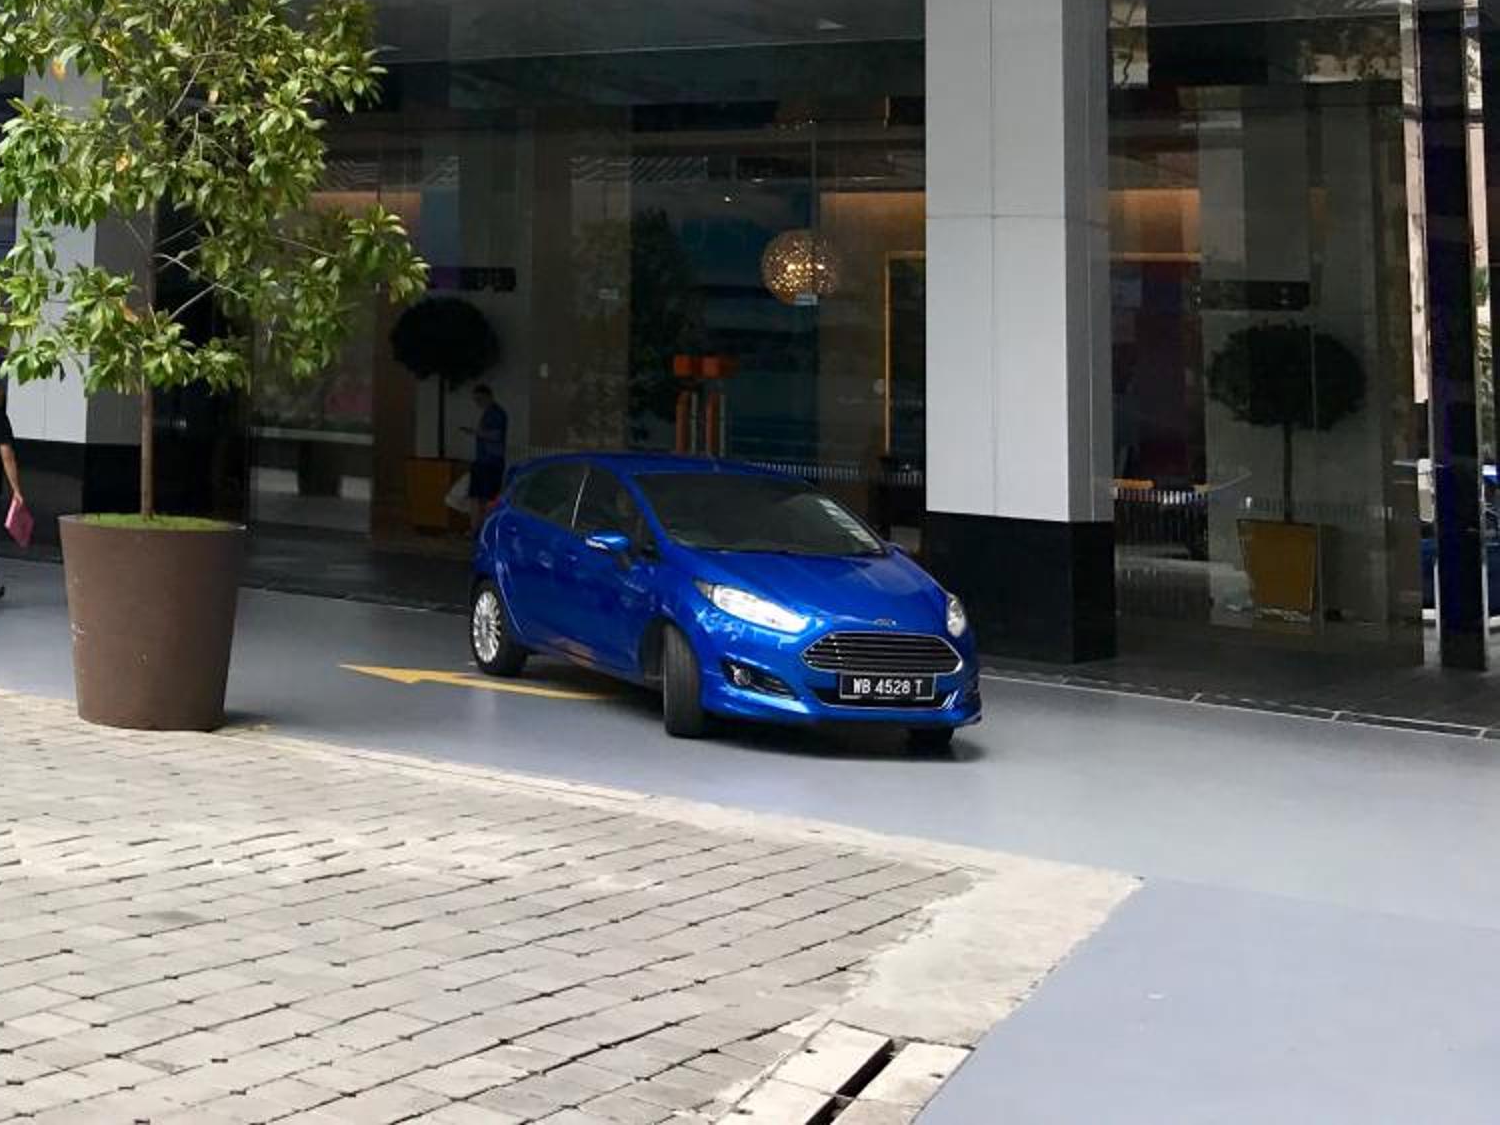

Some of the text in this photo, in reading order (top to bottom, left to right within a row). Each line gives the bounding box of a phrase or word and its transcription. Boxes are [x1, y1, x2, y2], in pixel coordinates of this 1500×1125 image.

[853, 678, 924, 695] WB 4528 T
